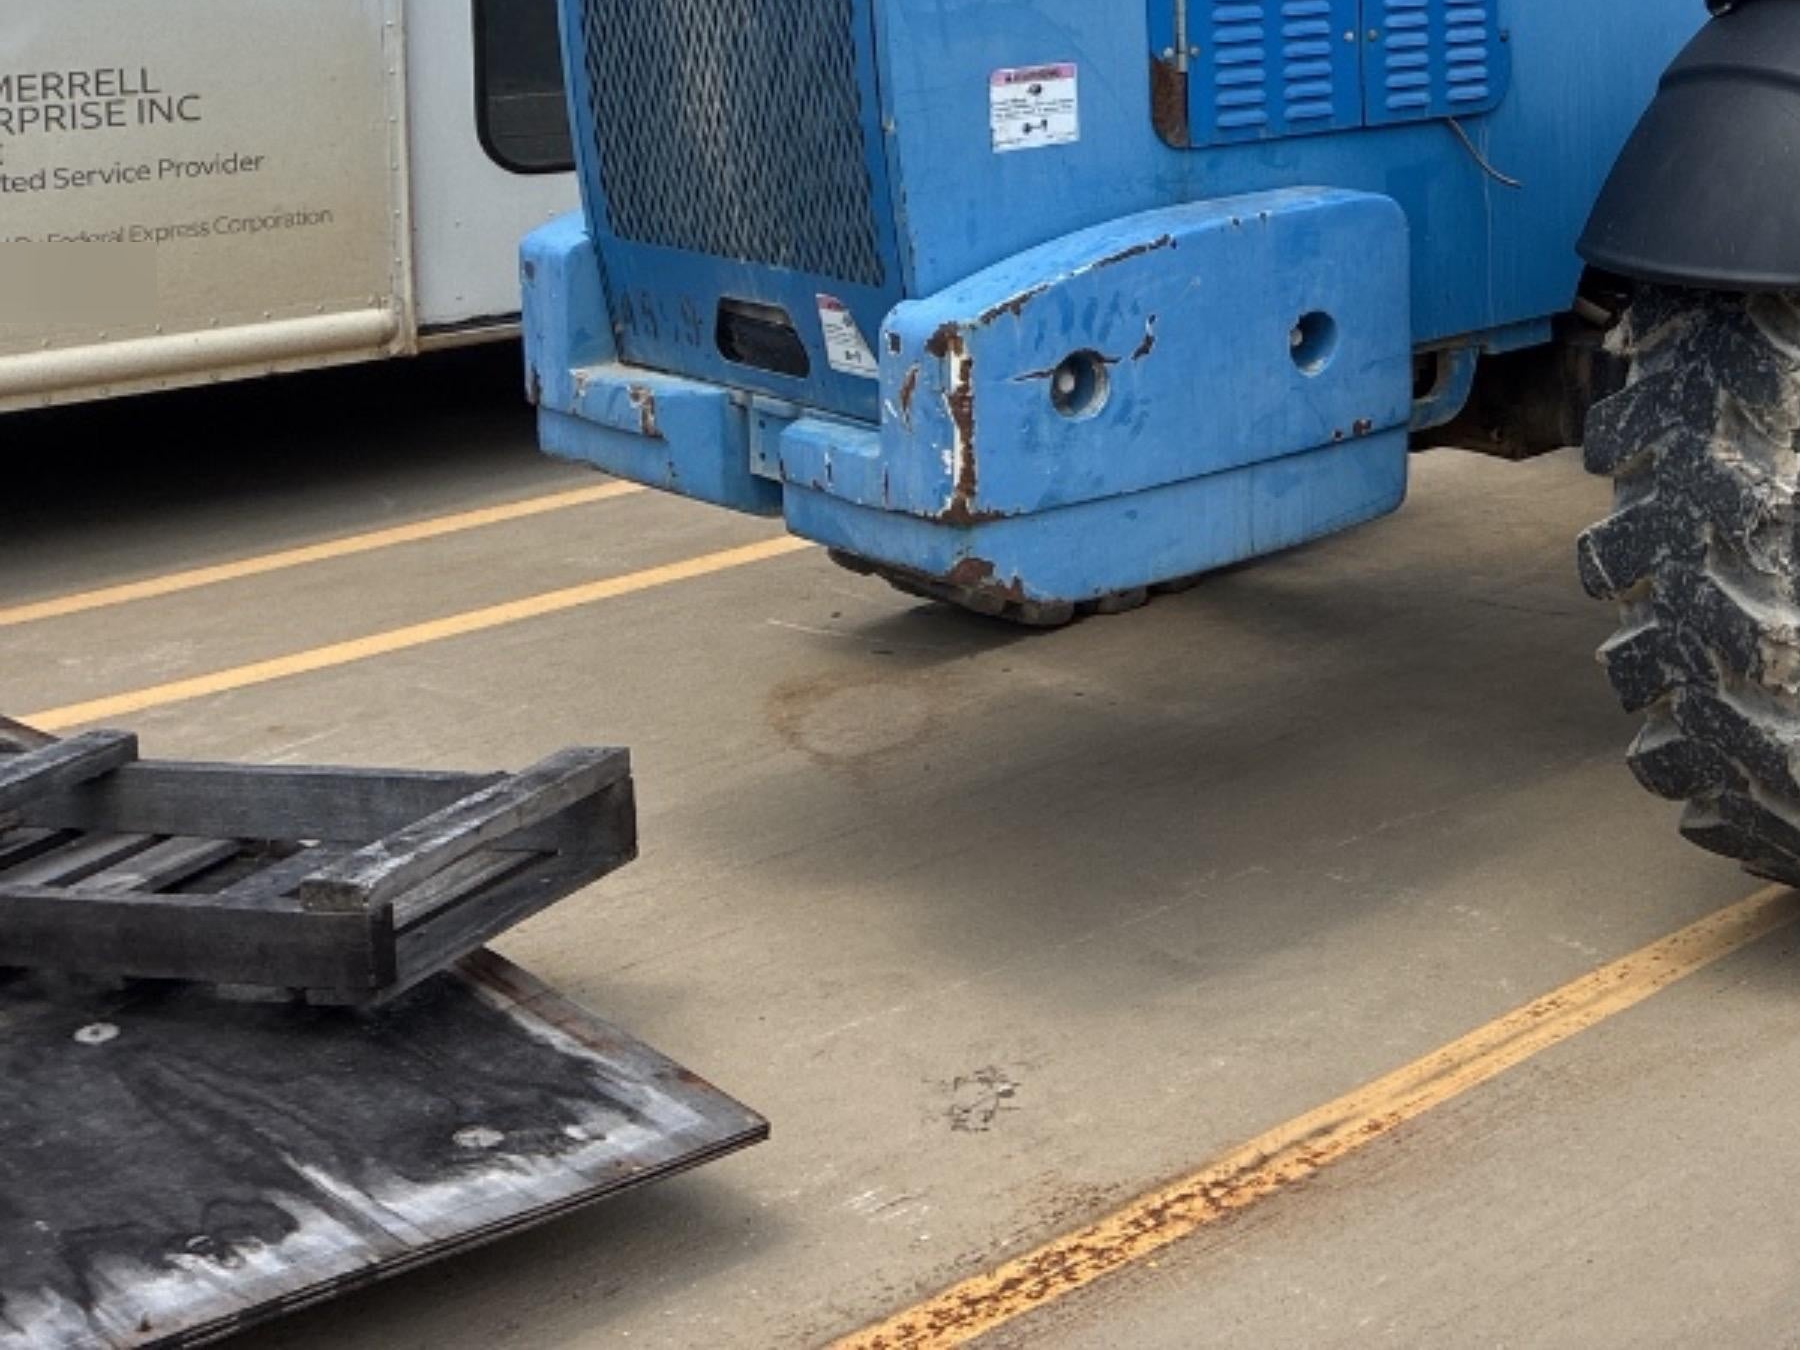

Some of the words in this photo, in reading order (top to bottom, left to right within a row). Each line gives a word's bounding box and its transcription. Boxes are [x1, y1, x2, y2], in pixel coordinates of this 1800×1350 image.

[136, 94, 203, 126] INC
[0, 168, 46, 194] ted
[53, 162, 152, 190] Service
[157, 152, 266, 181] Provider
[212, 207, 334, 236] Corporation
